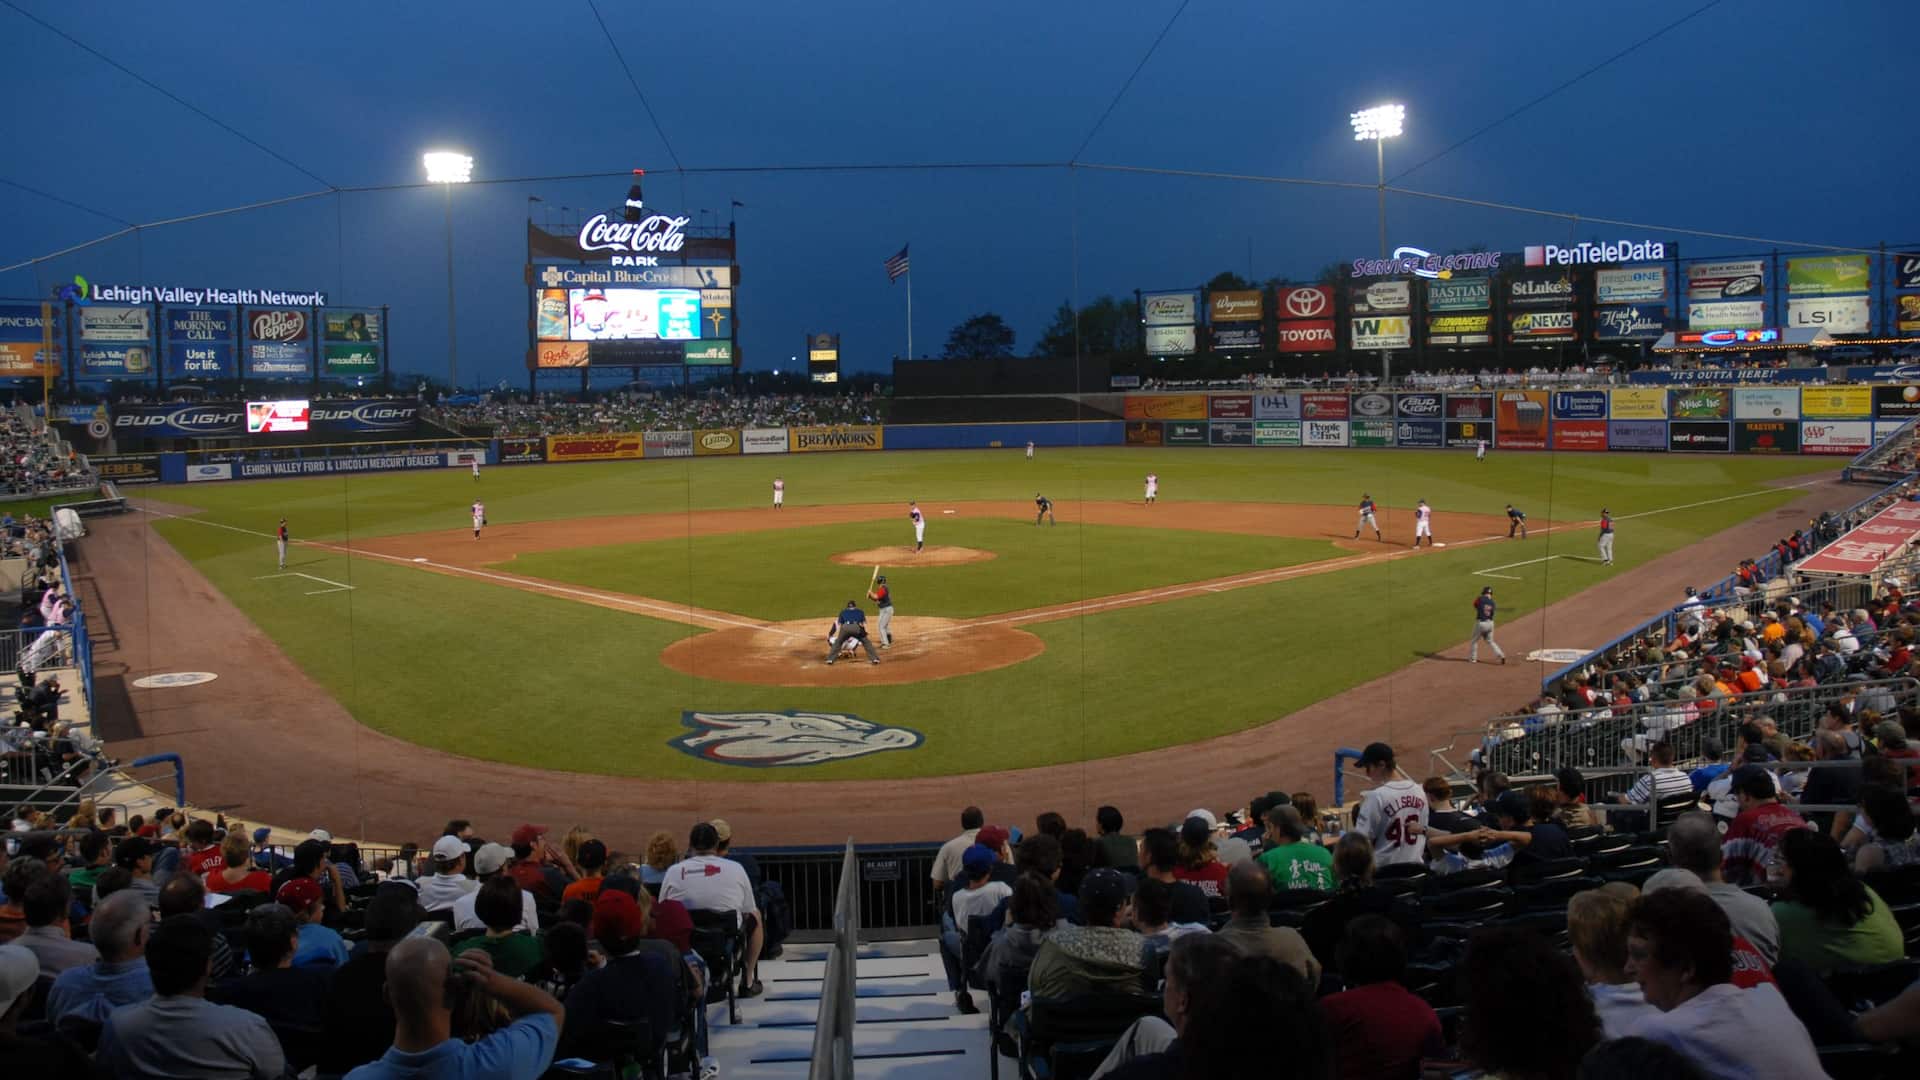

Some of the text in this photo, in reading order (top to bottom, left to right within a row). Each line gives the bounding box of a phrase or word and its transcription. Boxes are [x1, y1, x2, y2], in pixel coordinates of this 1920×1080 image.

[580, 215, 690, 252] Coca-Cola
[1545, 240, 1665, 266] PenTeleData
[611, 256, 658, 266] PARK
[563, 270, 612, 285] Capital
[93, 285, 325, 307] Lehigh Valley Health Network
[1430, 285, 1488, 298] BASTIAN
[187, 311, 212, 321] THE
[271, 311, 289, 326] Dr
[1531, 313, 1572, 329] NEWS
[1798, 311, 1832, 324] LSI
[174, 321, 226, 331] MORNING
[257, 315, 300, 340] Pepper
[187, 330, 216, 340] CALL
[1280, 329, 1334, 342] TOYOTA
[186, 349, 216, 360] Use it
[184, 359, 221, 371] for life.
[1697, 371, 1734, 380] OUTTA
[115, 412, 244, 427] BUD LIGHT
[310, 408, 416, 420] BUD LIGHT
[1263, 429, 1298, 437] LUTRON
[663, 447, 693, 457] team
[242, 456, 440, 476] LEHIGH VALLEY FORD & LINCOLN MERCURY DEALERS
[1385, 814, 1421, 848] 46
